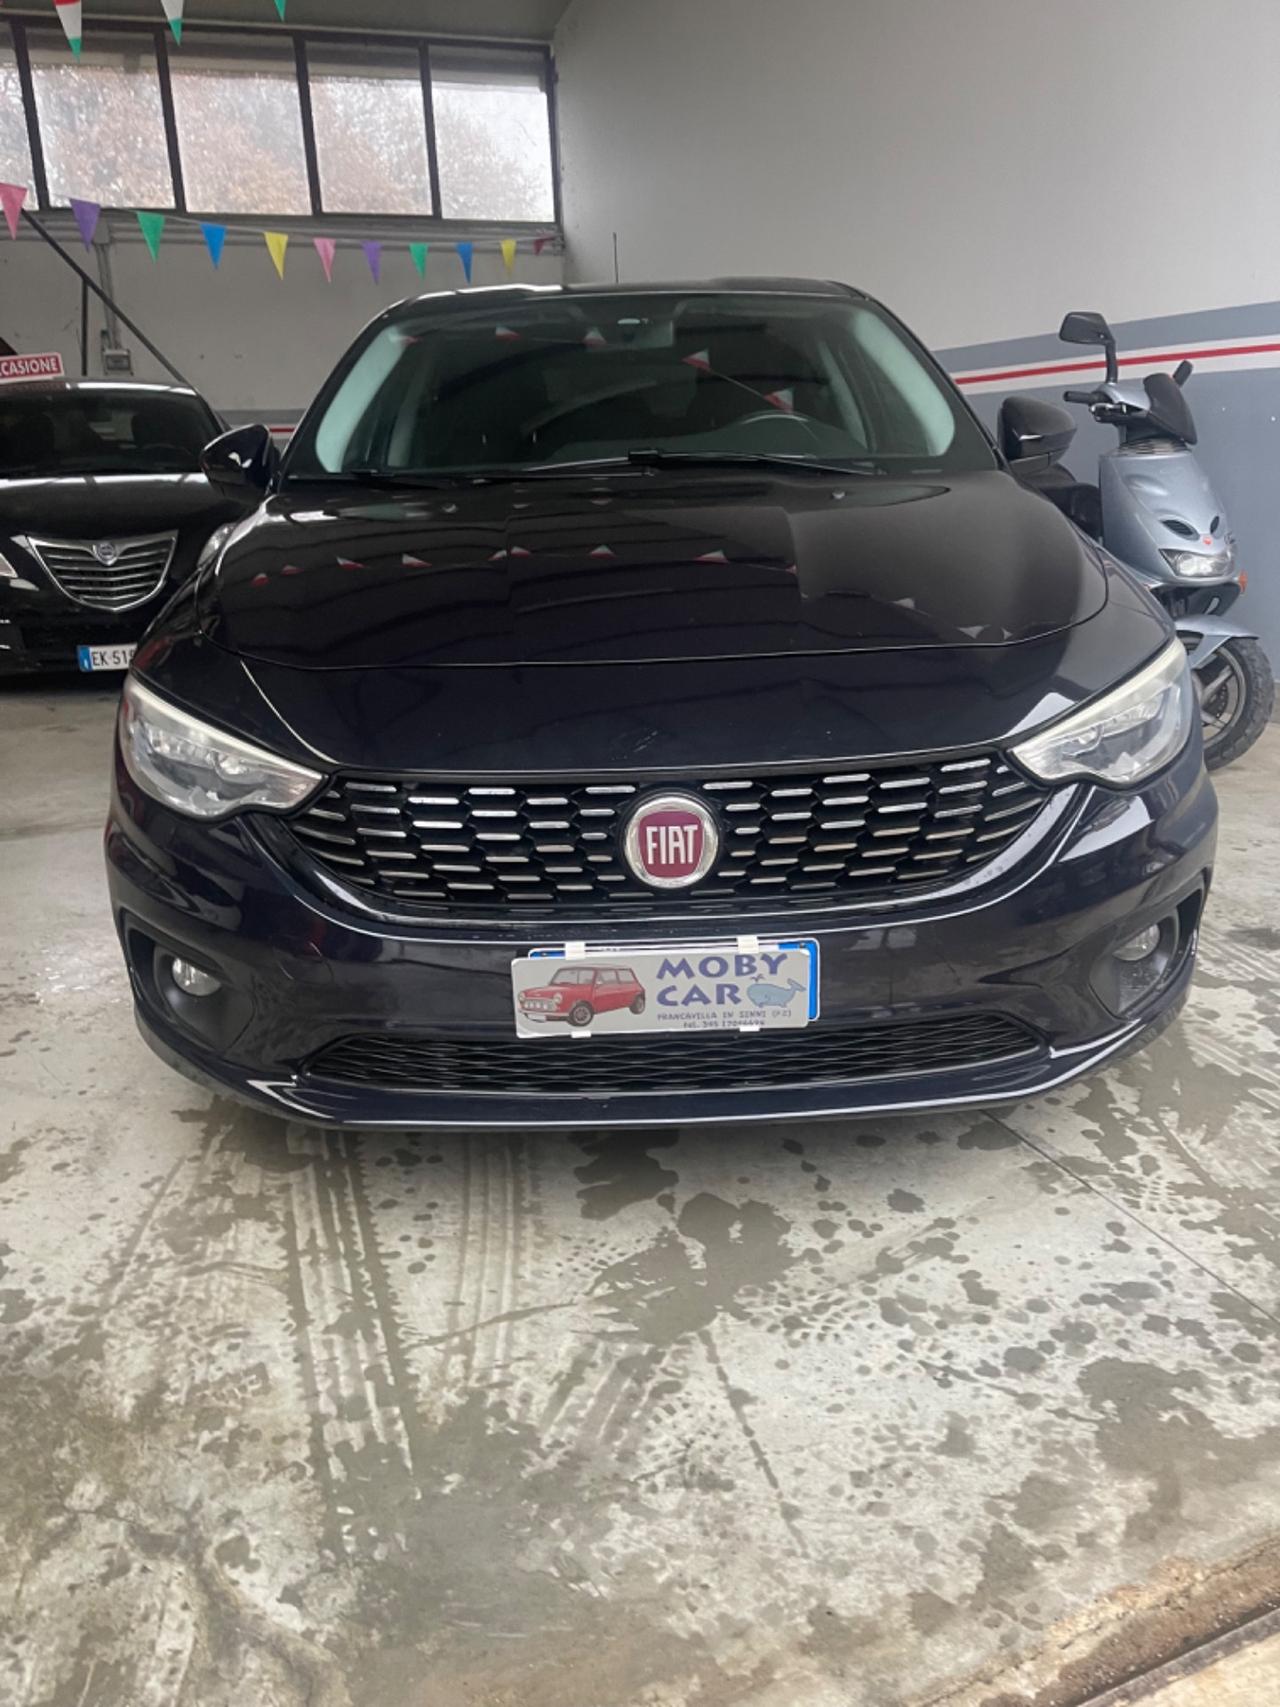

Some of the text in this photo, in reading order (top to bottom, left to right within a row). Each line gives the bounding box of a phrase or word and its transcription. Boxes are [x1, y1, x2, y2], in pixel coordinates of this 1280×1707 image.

[0, 357, 58, 377] CASIONE
[91, 650, 108, 666] EK
[646, 825, 698, 865] FIAT
[656, 953, 788, 980] MOBY
[656, 984, 743, 1007] CAR
